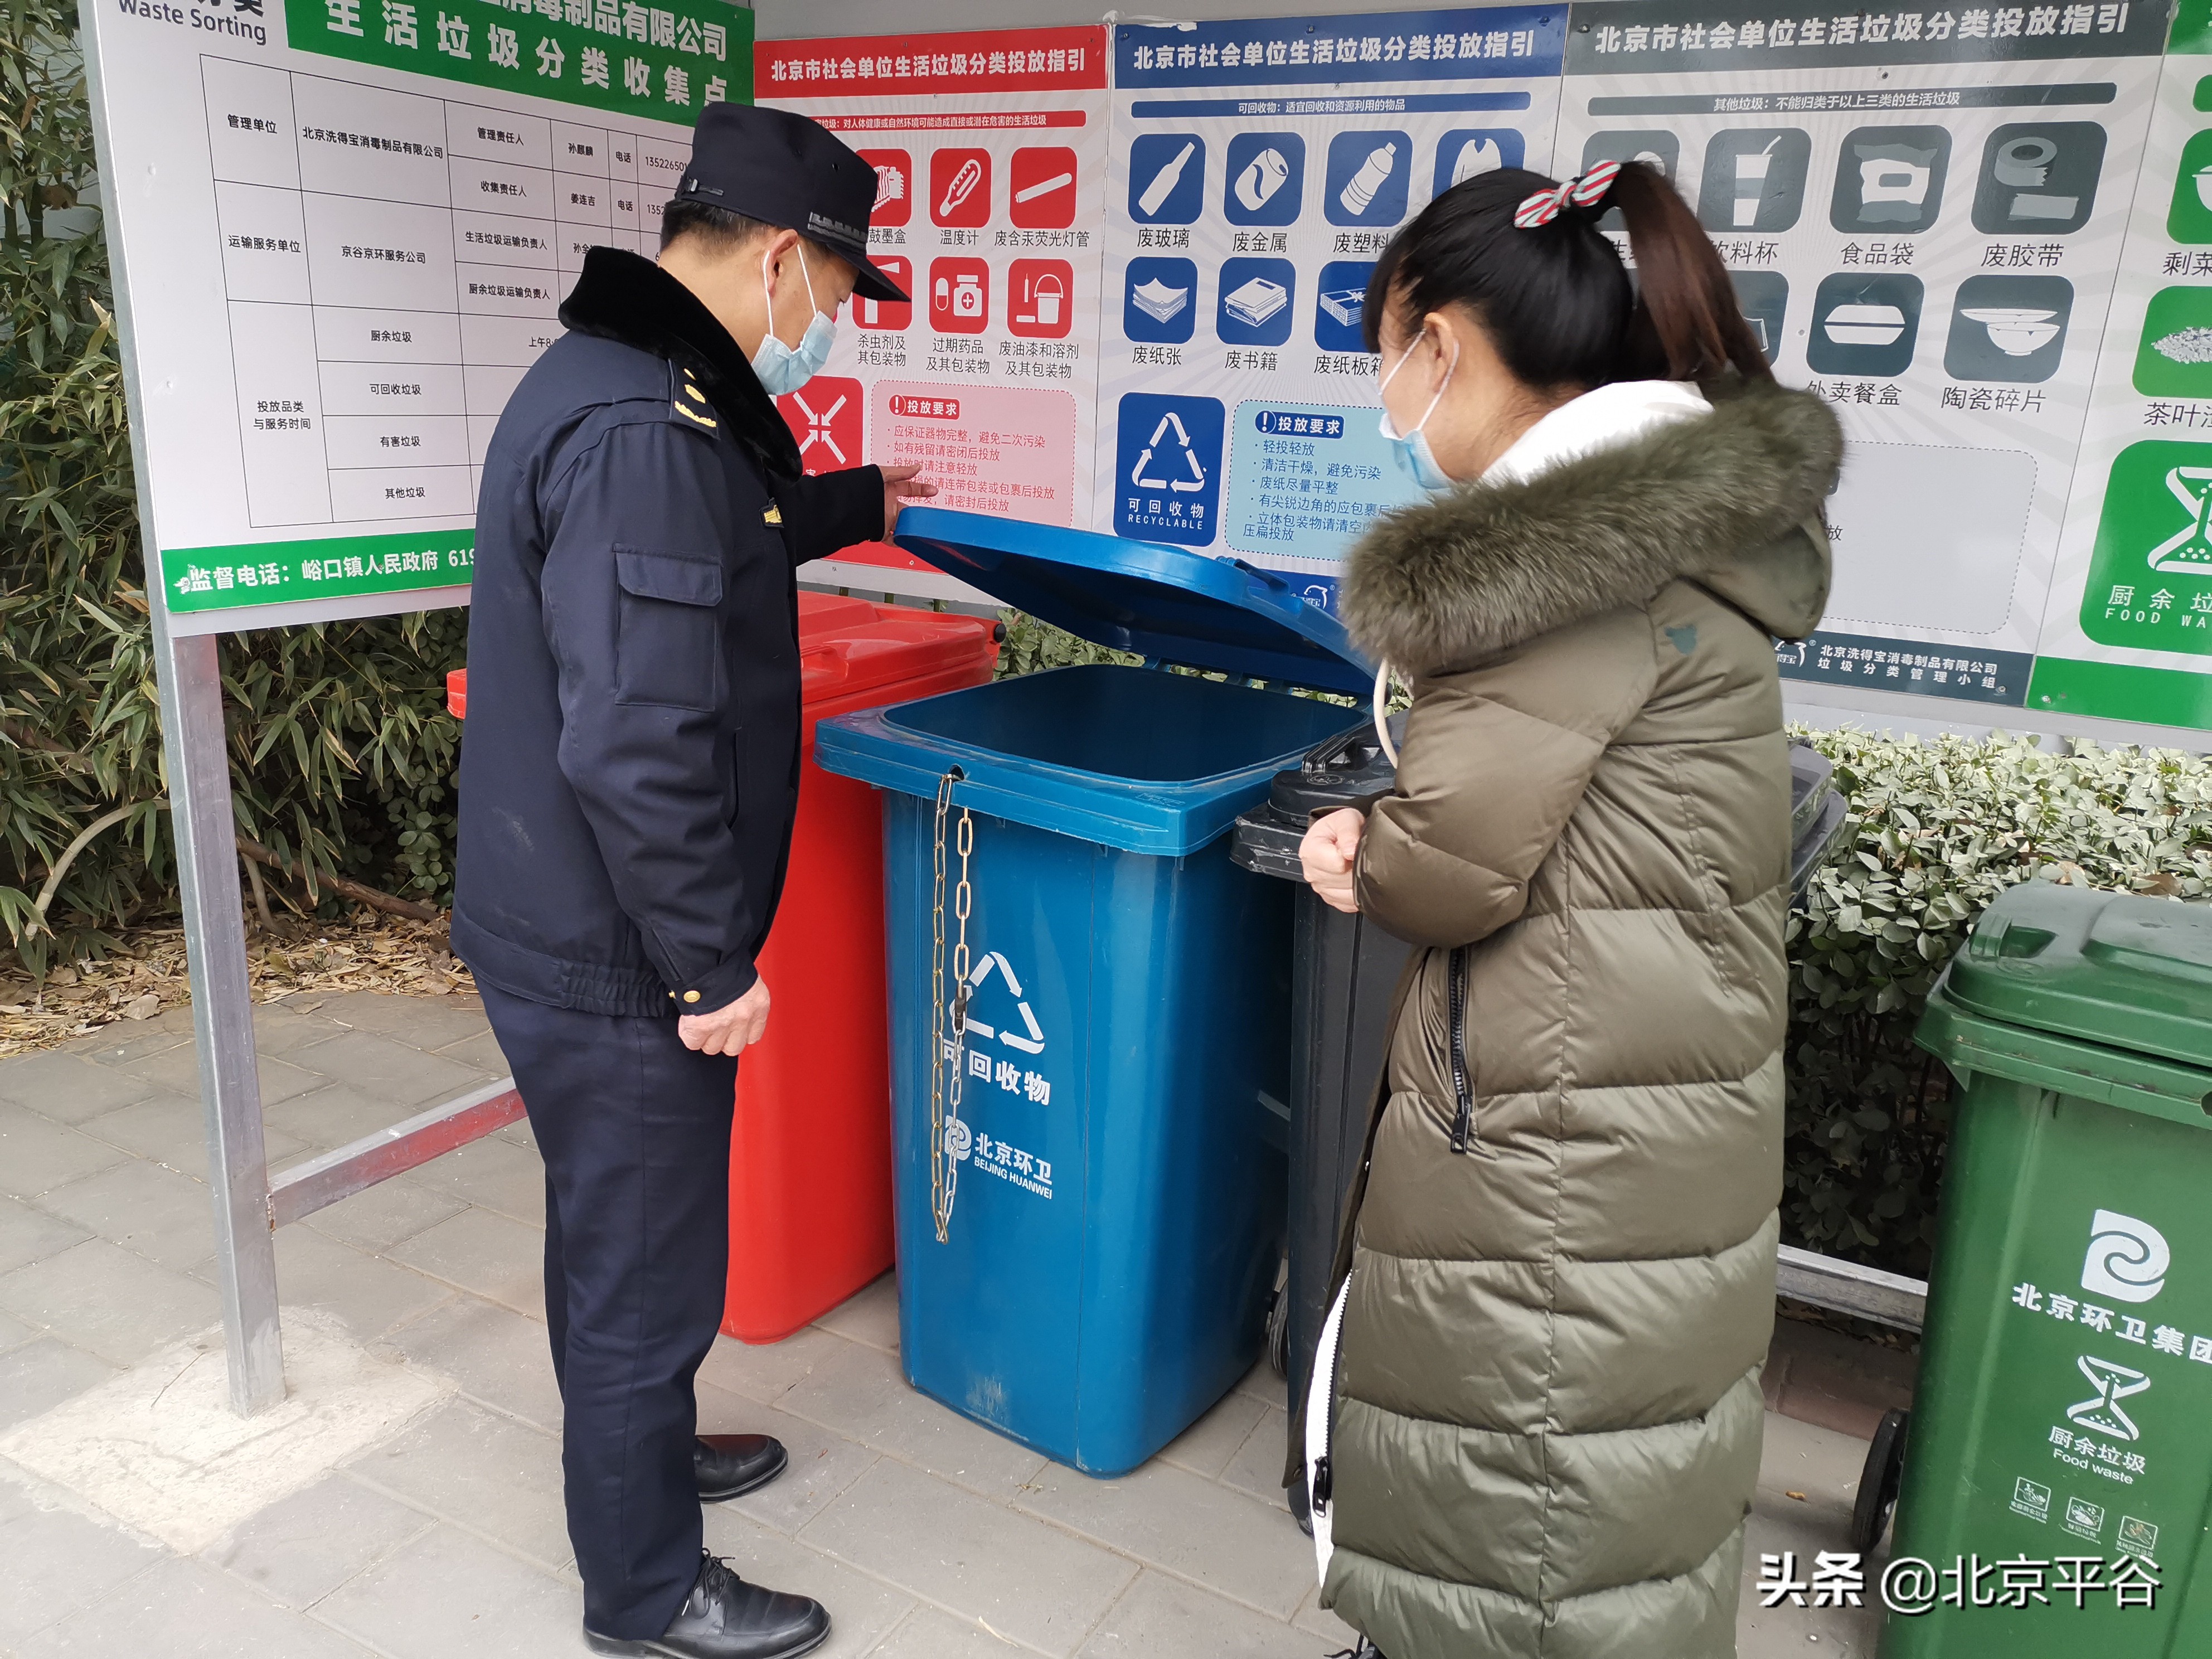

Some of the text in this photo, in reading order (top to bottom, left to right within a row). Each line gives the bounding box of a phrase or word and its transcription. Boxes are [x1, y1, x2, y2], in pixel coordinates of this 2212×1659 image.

[119, 0, 183, 25] Waste
[190, 8, 266, 46] Sorting
[1595, 2, 2129, 54] 北京市社会单位生活垃圾分类投放指引
[1133, 30, 1534, 70] 北京市社会单位生活垃圾分类投放指引
[772, 48, 1085, 81] 北京市社会单位生活垃圾分类投放指引
[1238, 98, 1405, 114] 可回收物：适宜回收和资源利用的物品
[1713, 91, 1961, 113] 其他垃圾：不能归类于以上三类的生活垃圾
[227, 113, 278, 134] 管理单位
[302, 126, 444, 159] 北京洗得宝消毒制品有限公司
[477, 127, 524, 145] 管理责任人
[615, 151, 632, 163] 电话
[481, 180, 527, 198] 收集责任人
[618, 200, 634, 212] 电话
[228, 235, 301, 254] 运输服务单位
[465, 231, 548, 250] 生活垃圾运输负责人
[940, 230, 979, 246] 温度计
[994, 230, 1090, 249] 废含汞荧光灯管
[1137, 227, 1190, 249] 废玻璃
[1232, 231, 1288, 254] 废金属
[341, 245, 426, 264] 京谷京环服务公司
[1840, 242, 1915, 268] 食品袋
[1982, 243, 2064, 268] 废胶带
[469, 283, 551, 300] 厨余垃圾运输负责人
[371, 329, 413, 343] 厨余垃圾
[858, 333, 906, 352] 杀虫剂及
[933, 337, 983, 355] 过期药品
[999, 341, 1079, 360] 废油漆和溶剂
[857, 351, 906, 367] 其包装物
[926, 357, 990, 374] 及其包装物
[1132, 346, 1182, 366] 废纸张
[1225, 351, 1278, 372] 废书籍
[1005, 361, 1072, 379] 及其包装物
[370, 382, 421, 396] 可回收垃圾
[1807, 380, 1902, 406] 外卖餐盒
[257, 400, 304, 414] 投放品类
[907, 399, 958, 417] 投放要求
[1941, 386, 2046, 414] 陶瓷碎片
[253, 417, 311, 430] 与服务时间
[1278, 416, 1340, 434] 投放要求
[380, 435, 421, 449] 有害垃圾
[894, 425, 1046, 448] 应保证器物完整，避免二次污染
[894, 441, 1000, 462] 如有残留请密闭后投放
[1263, 439, 1314, 457] 轻投轻放
[1261, 458, 1382, 481] 清洁干燥，避免污染
[385, 486, 426, 499] 其他垃圾
[1259, 476, 1338, 495] 废纸尽量平整
[1128, 498, 1204, 519] 可回收物
[1128, 513, 1203, 530] RECYCLABLE
[1243, 523, 1294, 542] 压扁投放
[2105, 608, 2161, 624] FOOD
[1821, 644, 1997, 676] 北京洗得宝消毒制品有限公司
[1817, 658, 1996, 689] 垃圾分类管理小组
[974, 1132, 1052, 1185] 北京环卫
[974, 1156, 1052, 1200] BEIJING HUANWEI
[2048, 1425, 2146, 1474] 厨余垃圾
[2053, 1448, 2134, 1485] Food waste
